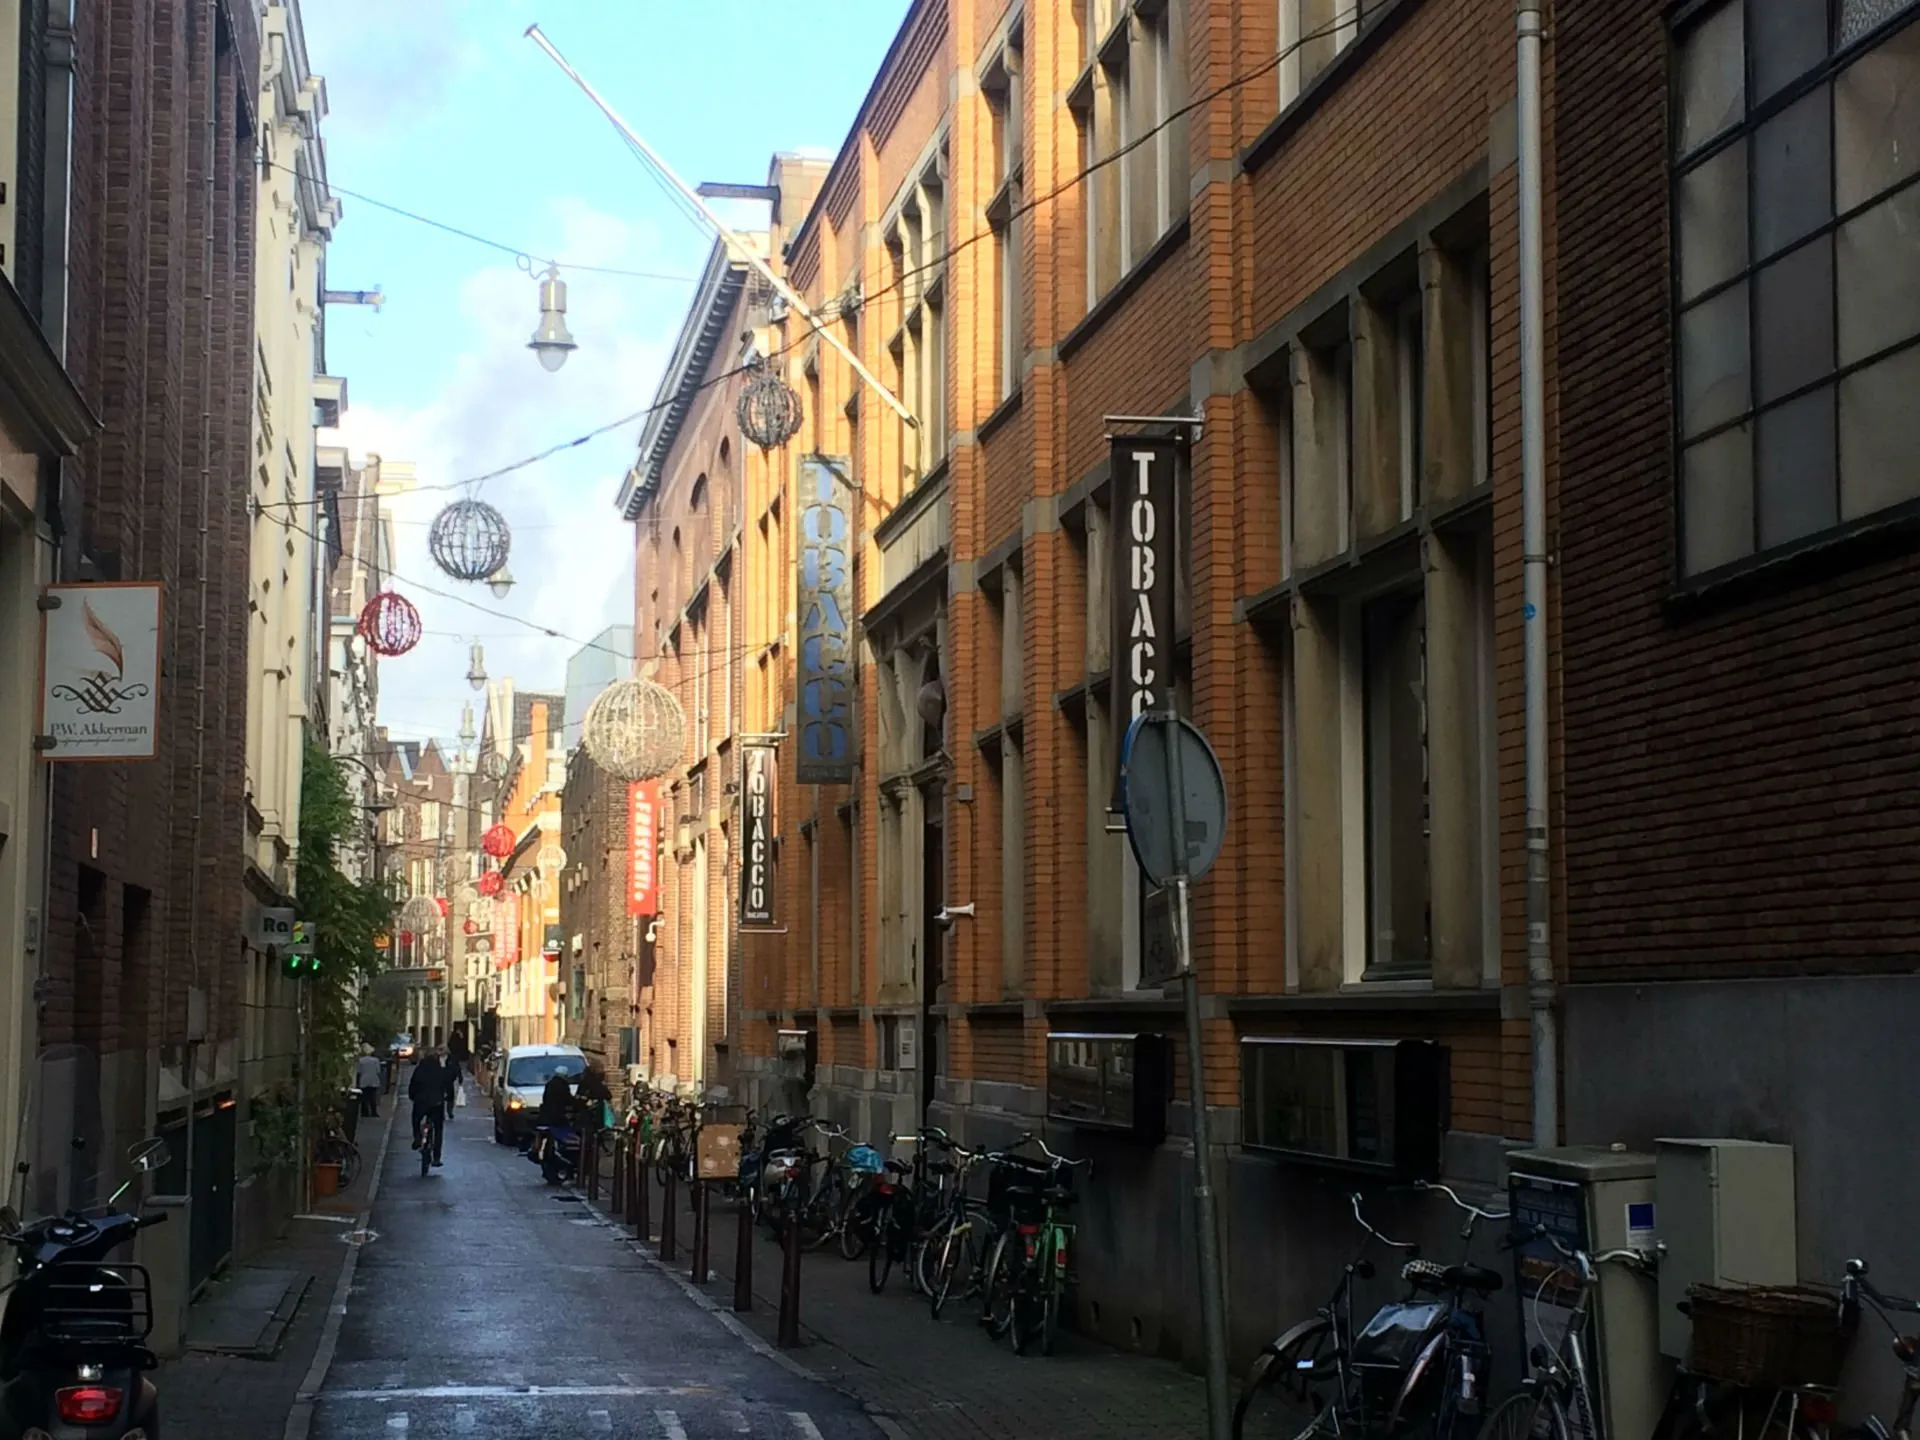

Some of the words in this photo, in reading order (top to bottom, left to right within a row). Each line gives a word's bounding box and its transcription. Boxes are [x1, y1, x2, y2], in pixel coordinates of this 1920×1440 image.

[803, 460, 846, 757] TOBACCO
[1131, 452, 1155, 721] TOBACC
[79, 722, 148, 736] Akkerman
[751, 750, 765, 909] TOBACCO
[263, 916, 289, 933] Ra
